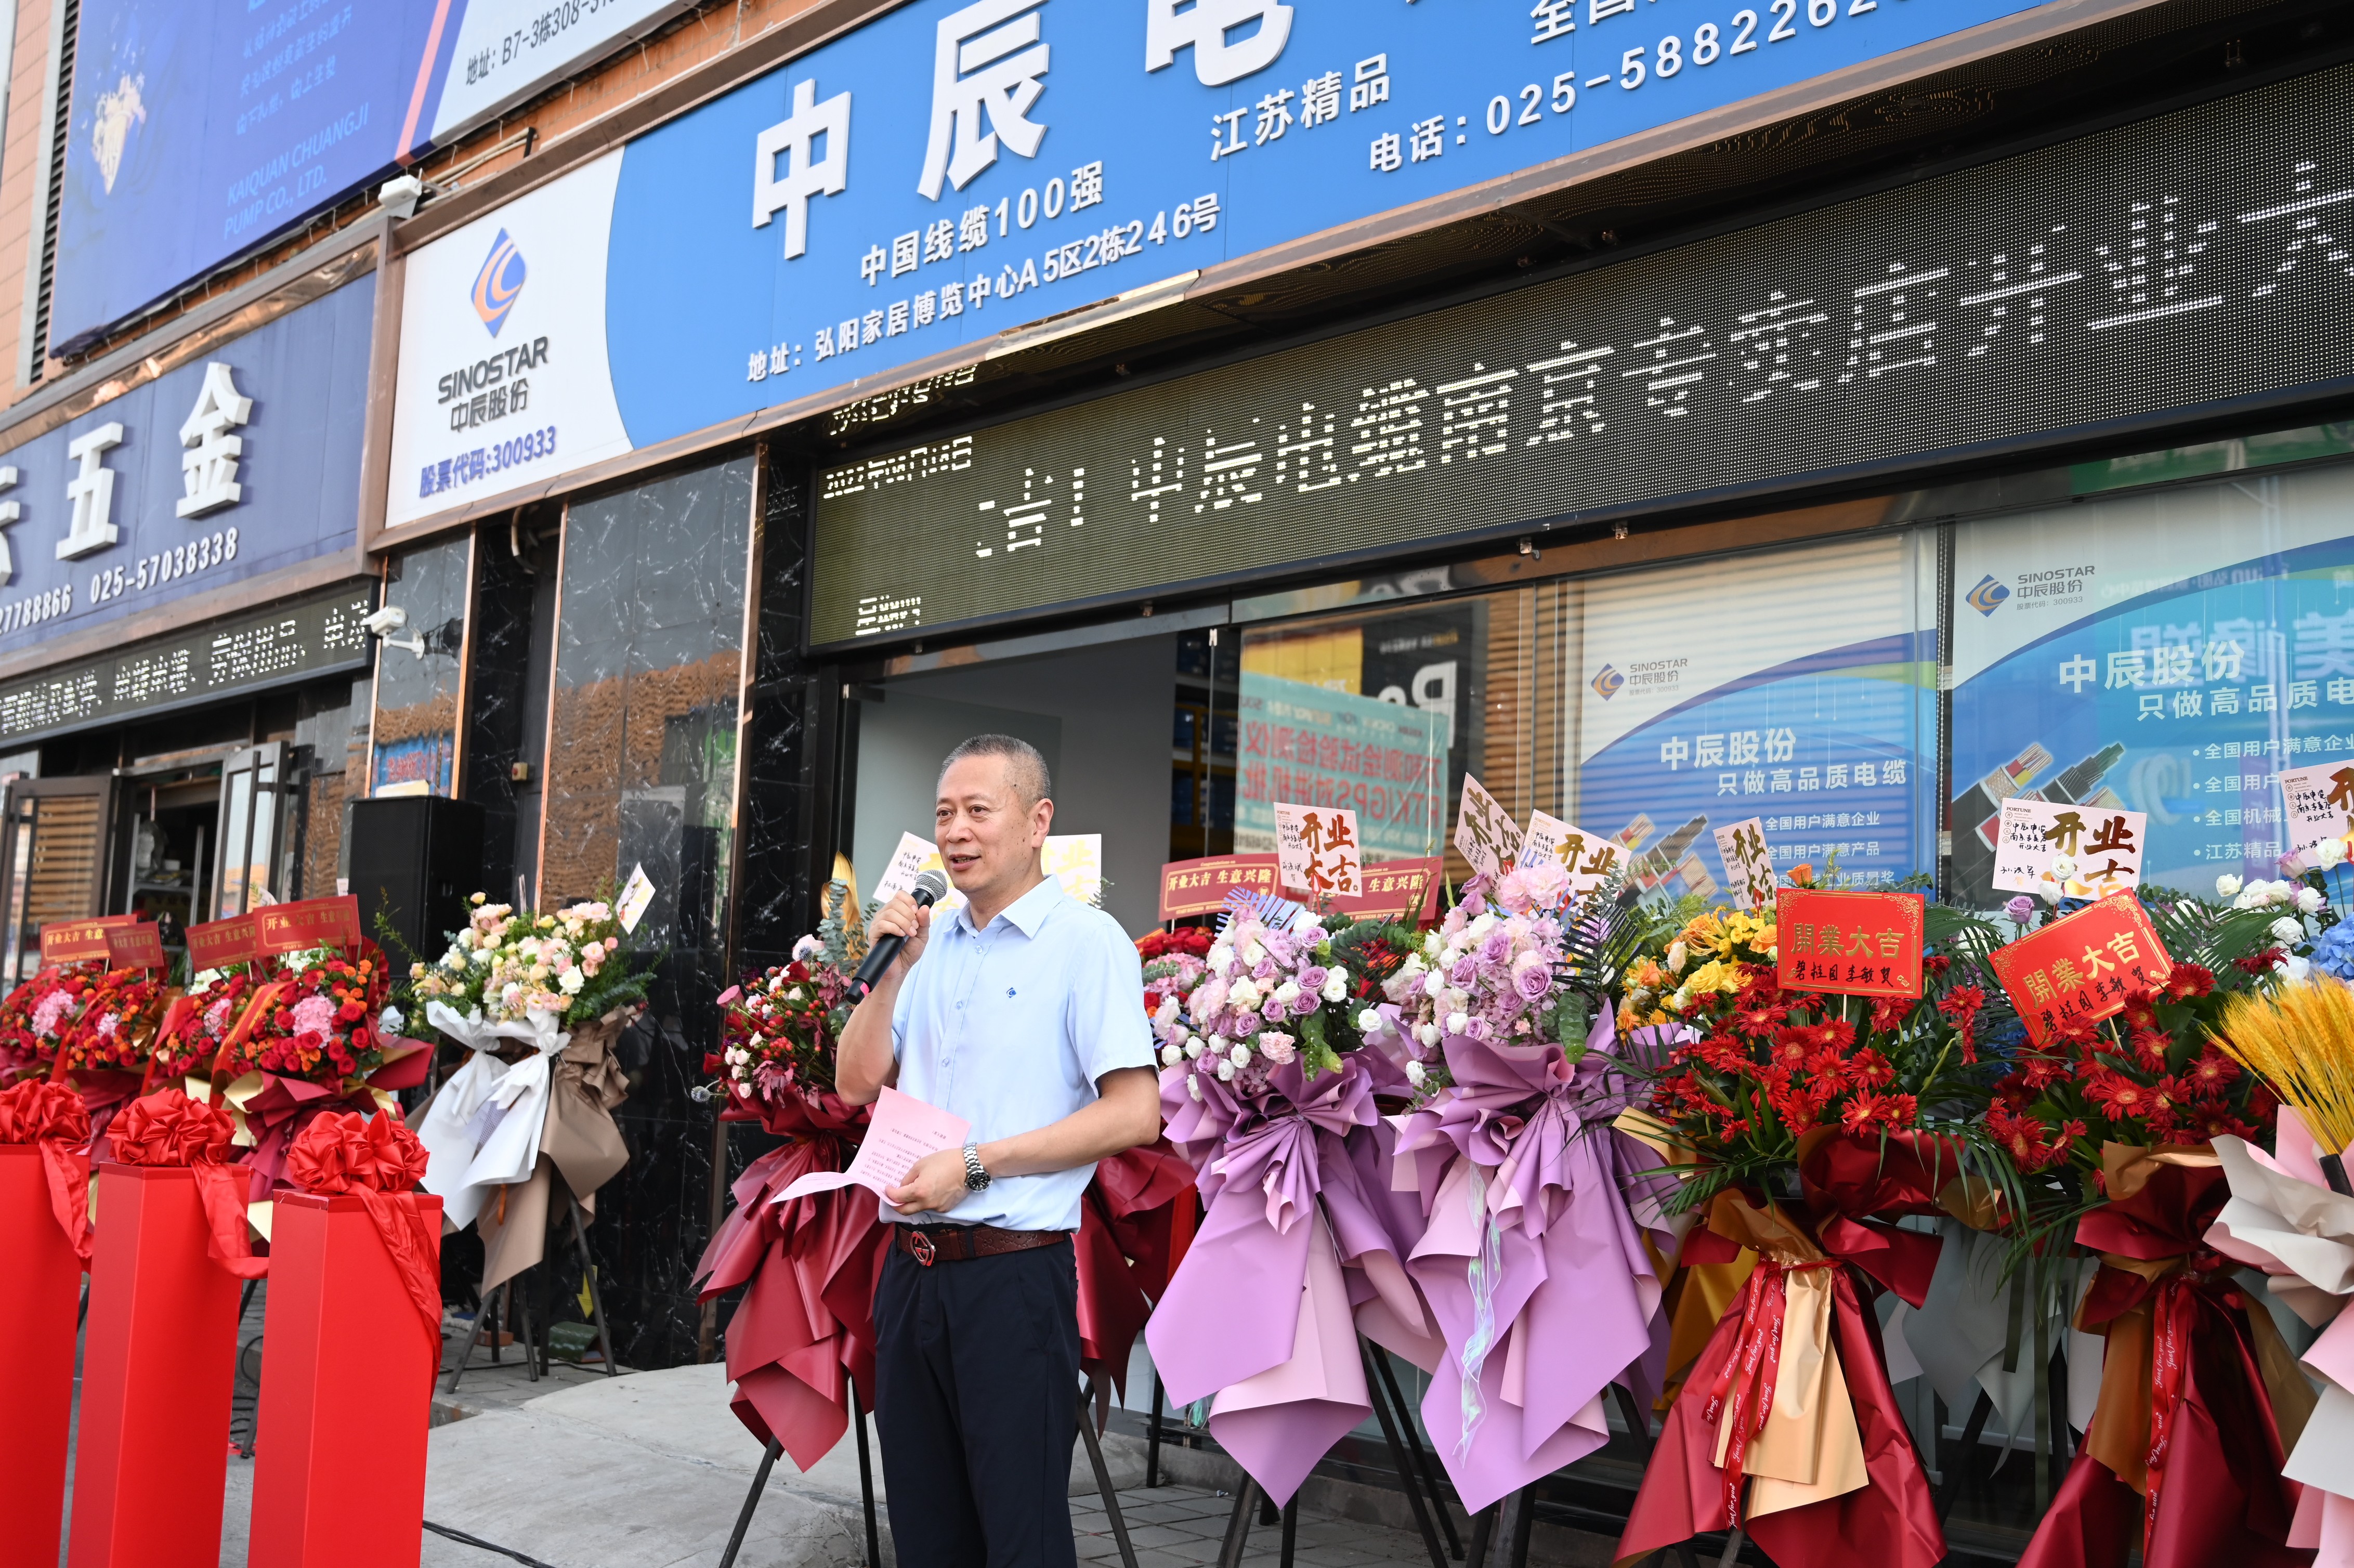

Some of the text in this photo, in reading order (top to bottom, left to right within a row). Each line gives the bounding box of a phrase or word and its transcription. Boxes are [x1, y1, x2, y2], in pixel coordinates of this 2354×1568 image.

[466, 0, 616, 86] 地址:B7-3栋308-
[1210, 53, 1390, 162] 江苏精品
[227, 102, 369, 207] KAIQUAN CHUANGJI
[224, 164, 327, 240] PUMP CO., LTD.
[861, 161, 1104, 288] 中国线缆100强
[438, 336, 549, 404] SINOSTAR
[450, 377, 529, 433] 中辰股份
[0, 361, 254, 588] 五金
[419, 426, 557, 498] 股票代码:300933
[90, 527, 239, 604] 025-57038338
[2018, 565, 2095, 584] SINOSTAR
[2017, 579, 2083, 598] 中辰股份
[1629, 670, 1679, 686] 中辰股份
[1630, 658, 1688, 673] SINOSTAR
[2059, 639, 2245, 694] 中辰股份
[2136, 675, 2354, 722] 只做高品质电
[1660, 727, 1797, 770] 中辰股份
[1717, 760, 1906, 796] 只做高品质电缆
[1300, 812, 1354, 854] 开业
[1765, 811, 1880, 831] 全国用户满意企业
[2045, 812, 2136, 857] 开业
[2205, 806, 2288, 826] 全国机械
[1555, 833, 1617, 877] 开业
[1732, 824, 1766, 869] 开业
[1768, 841, 1880, 860] 全国用户满意产品
[2205, 841, 2281, 860] 江苏精品
[1168, 868, 1272, 891] 开业大吉 生意兴隆
[1304, 852, 1357, 893] 大吉
[1368, 874, 1423, 893] 生意兴隆
[1790, 923, 1905, 959] 開業大吉
[2022, 931, 2140, 1009] 開業大吉
